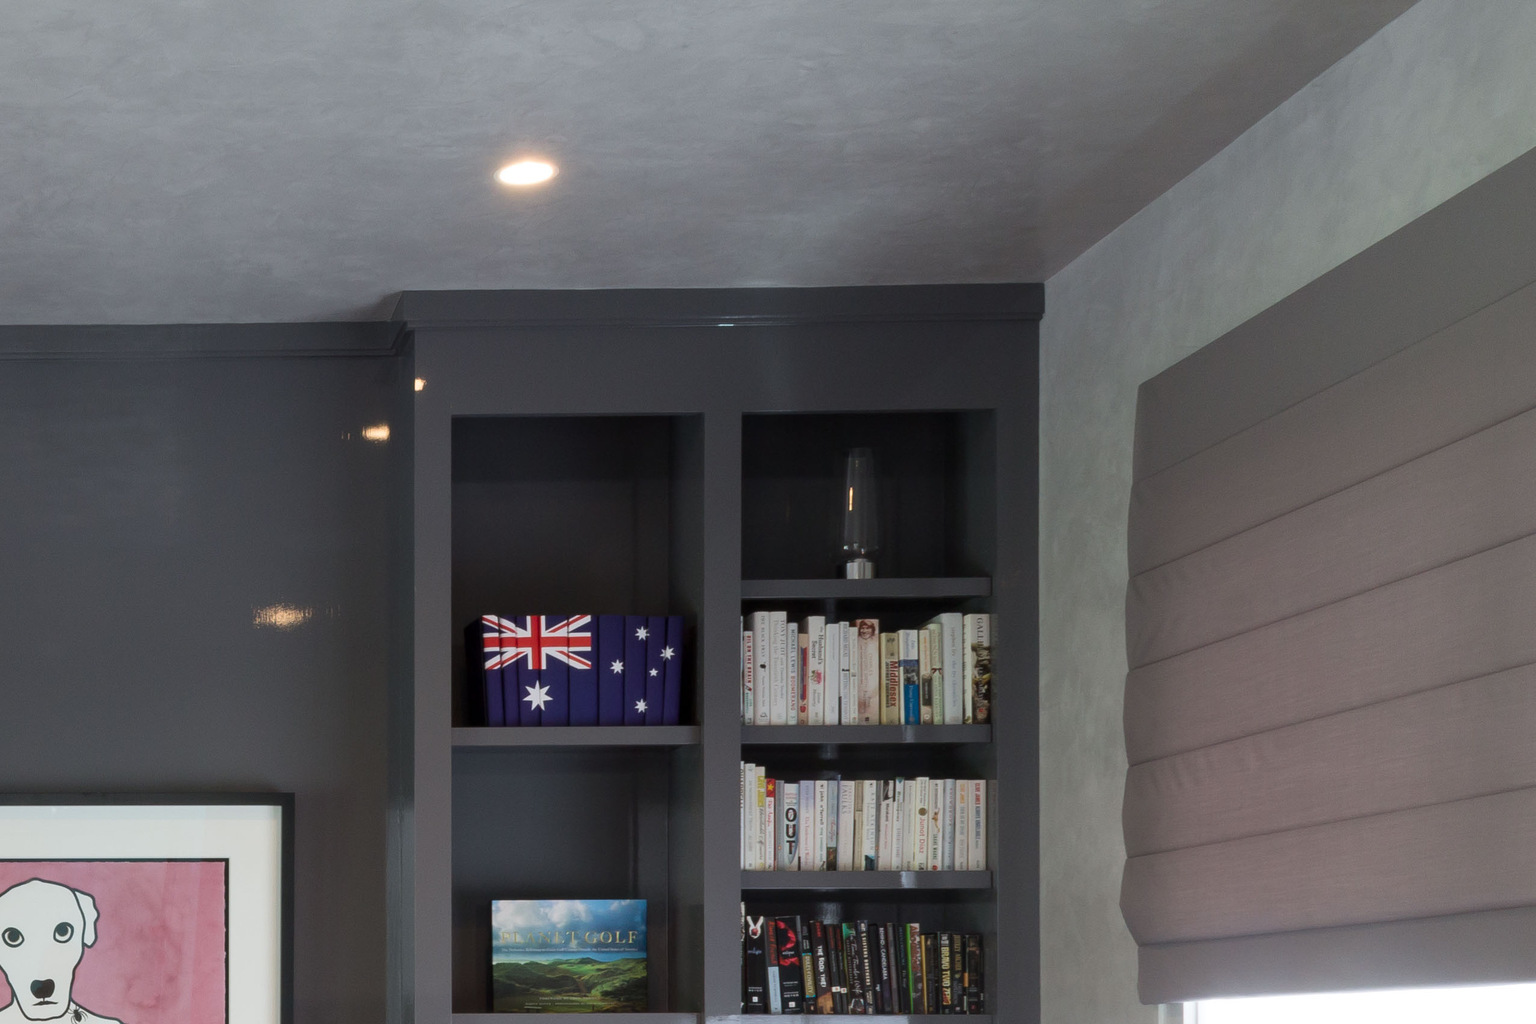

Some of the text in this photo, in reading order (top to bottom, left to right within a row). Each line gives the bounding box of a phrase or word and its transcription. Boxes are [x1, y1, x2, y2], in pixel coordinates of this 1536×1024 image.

[746, 645, 752, 653] ON
[890, 660, 898, 707] Middlesex
[786, 807, 797, 855] OUT
[500, 930, 638, 945] PLANET GOLF
[863, 959, 871, 986] BROTHERS
[880, 948, 888, 980] CANDELABRA
[941, 946, 952, 1006] BRAVO TWO ZERO
